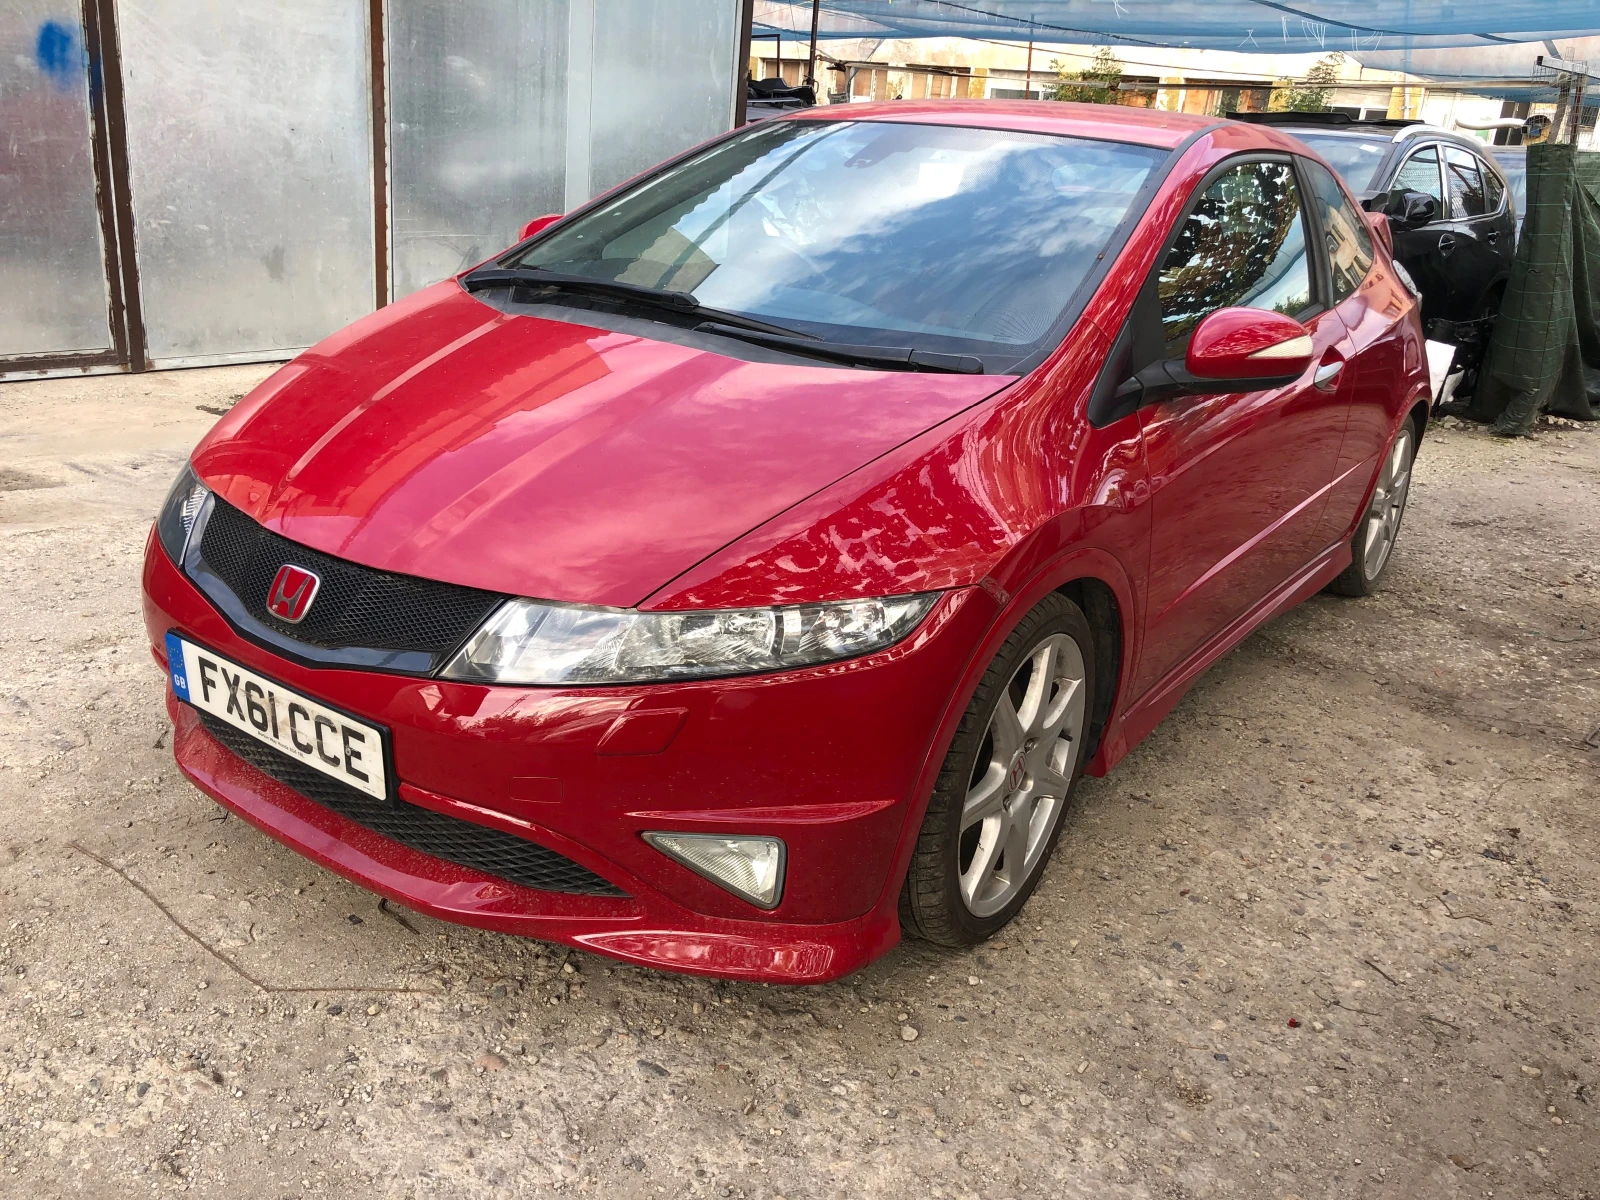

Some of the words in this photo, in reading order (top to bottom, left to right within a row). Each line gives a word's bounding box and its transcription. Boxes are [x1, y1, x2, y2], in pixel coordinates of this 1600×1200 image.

[174, 673, 187, 690] GB
[198, 655, 280, 740] FX61
[288, 702, 370, 784] CCE
